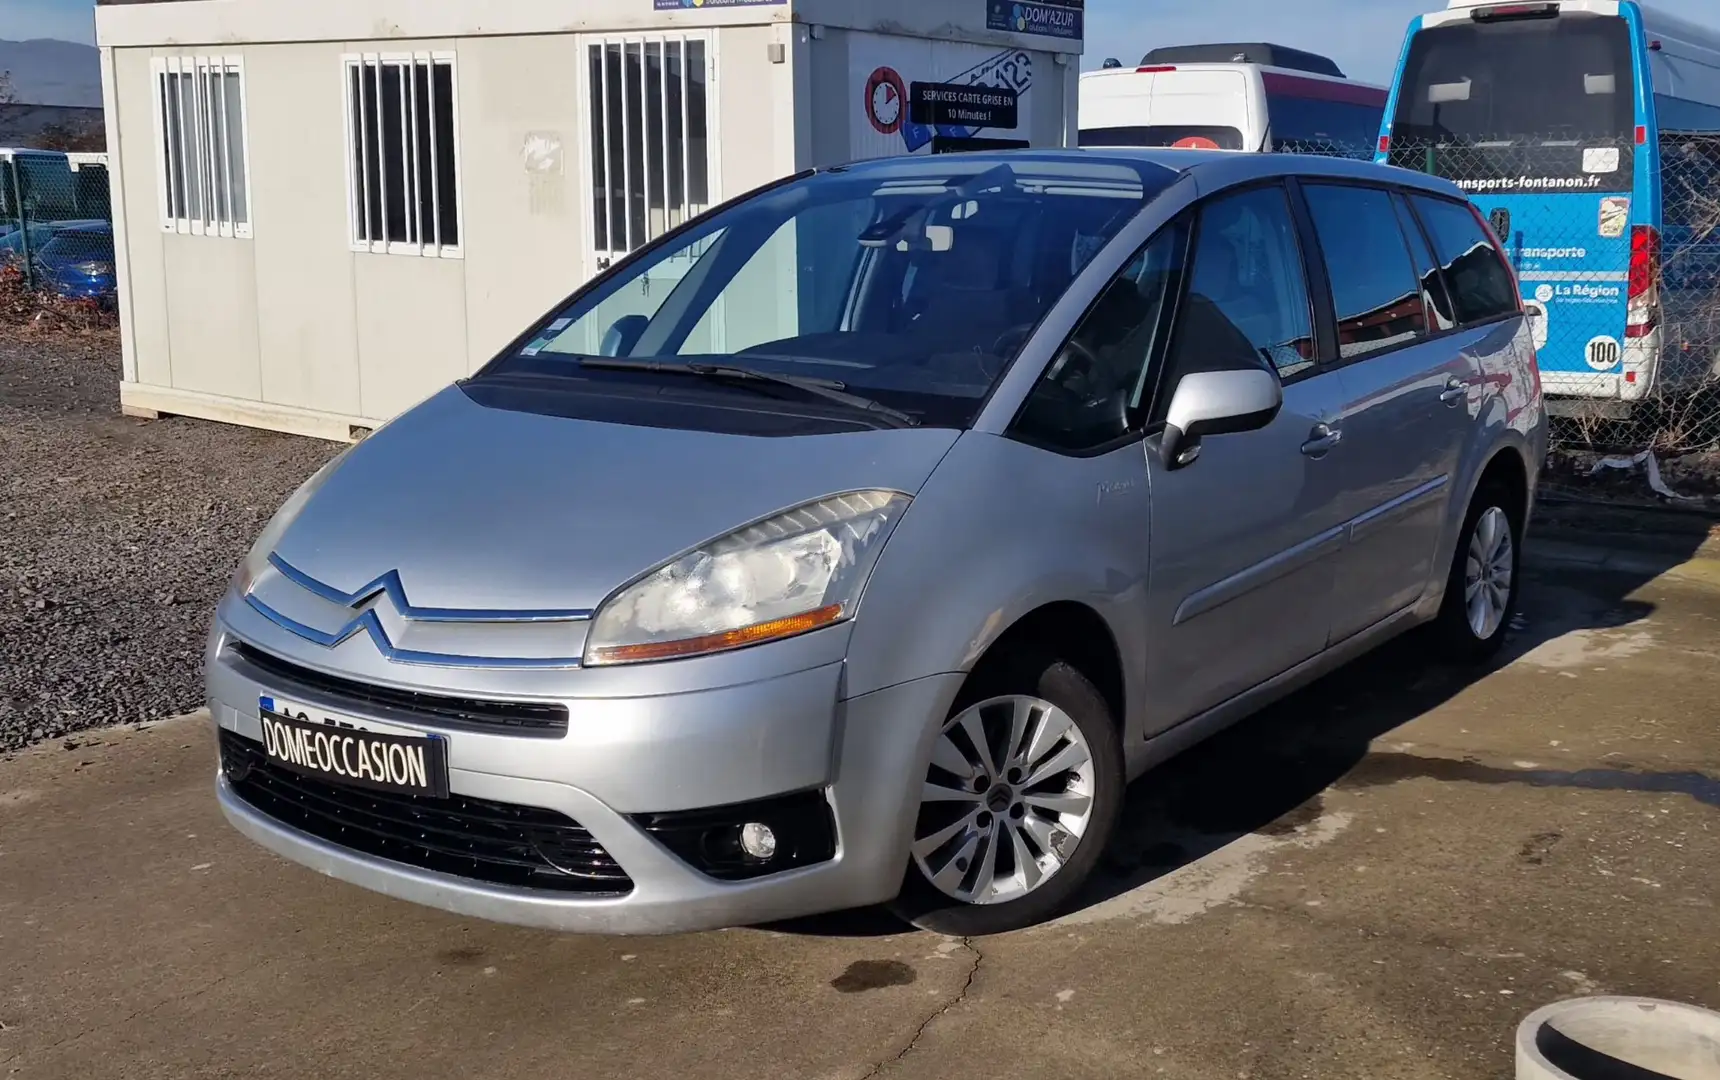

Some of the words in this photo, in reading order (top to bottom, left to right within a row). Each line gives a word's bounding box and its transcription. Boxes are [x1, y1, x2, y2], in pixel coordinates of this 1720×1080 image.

[1025, 7, 1074, 27] DOM'AZUR
[922, 90, 957, 102] SERVICES
[958, 92, 981, 104] CARTE
[982, 94, 1002, 106] GRISE
[1003, 96, 1013, 106] EN
[948, 109, 956, 119] 10
[958, 109, 987, 120] Minutes
[1513, 247, 1586, 259] ransporte
[1555, 284, 1571, 296] La
[1573, 284, 1619, 298] Région
[1589, 342, 1617, 363] 100
[263, 717, 427, 788] DOMEOCCASION
